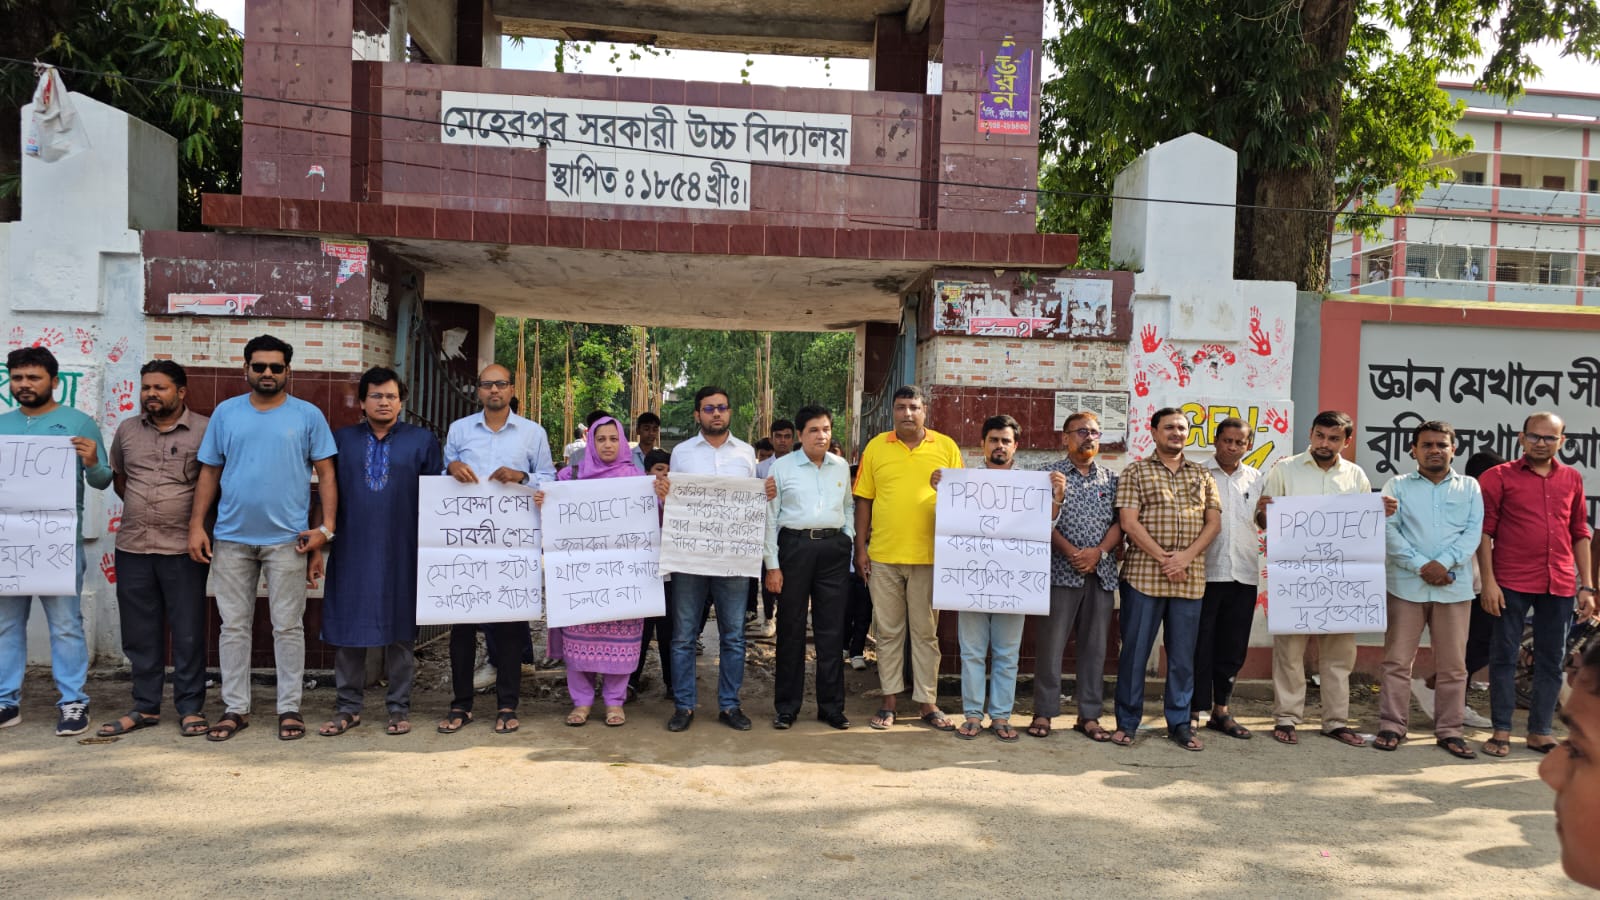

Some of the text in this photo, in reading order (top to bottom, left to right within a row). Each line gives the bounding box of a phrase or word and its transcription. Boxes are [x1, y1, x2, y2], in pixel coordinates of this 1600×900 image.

[443, 105, 849, 159] মেহেরপুর সরকারী উচ্চ বিদ্যালয়
[549, 153, 619, 198] স্থাপিত
[1368, 358, 1444, 403] জ্ঞান
[1449, 361, 1563, 406] যেখানে
[0, 442, 76, 479] JECT
[949, 481, 1050, 513] PROJECT
[979, 515, 1000, 536] কে
[1280, 509, 1384, 539] PROJECT
[947, 534, 995, 558] করলে
[941, 559, 1049, 594] মাধ্যমিক হবে
